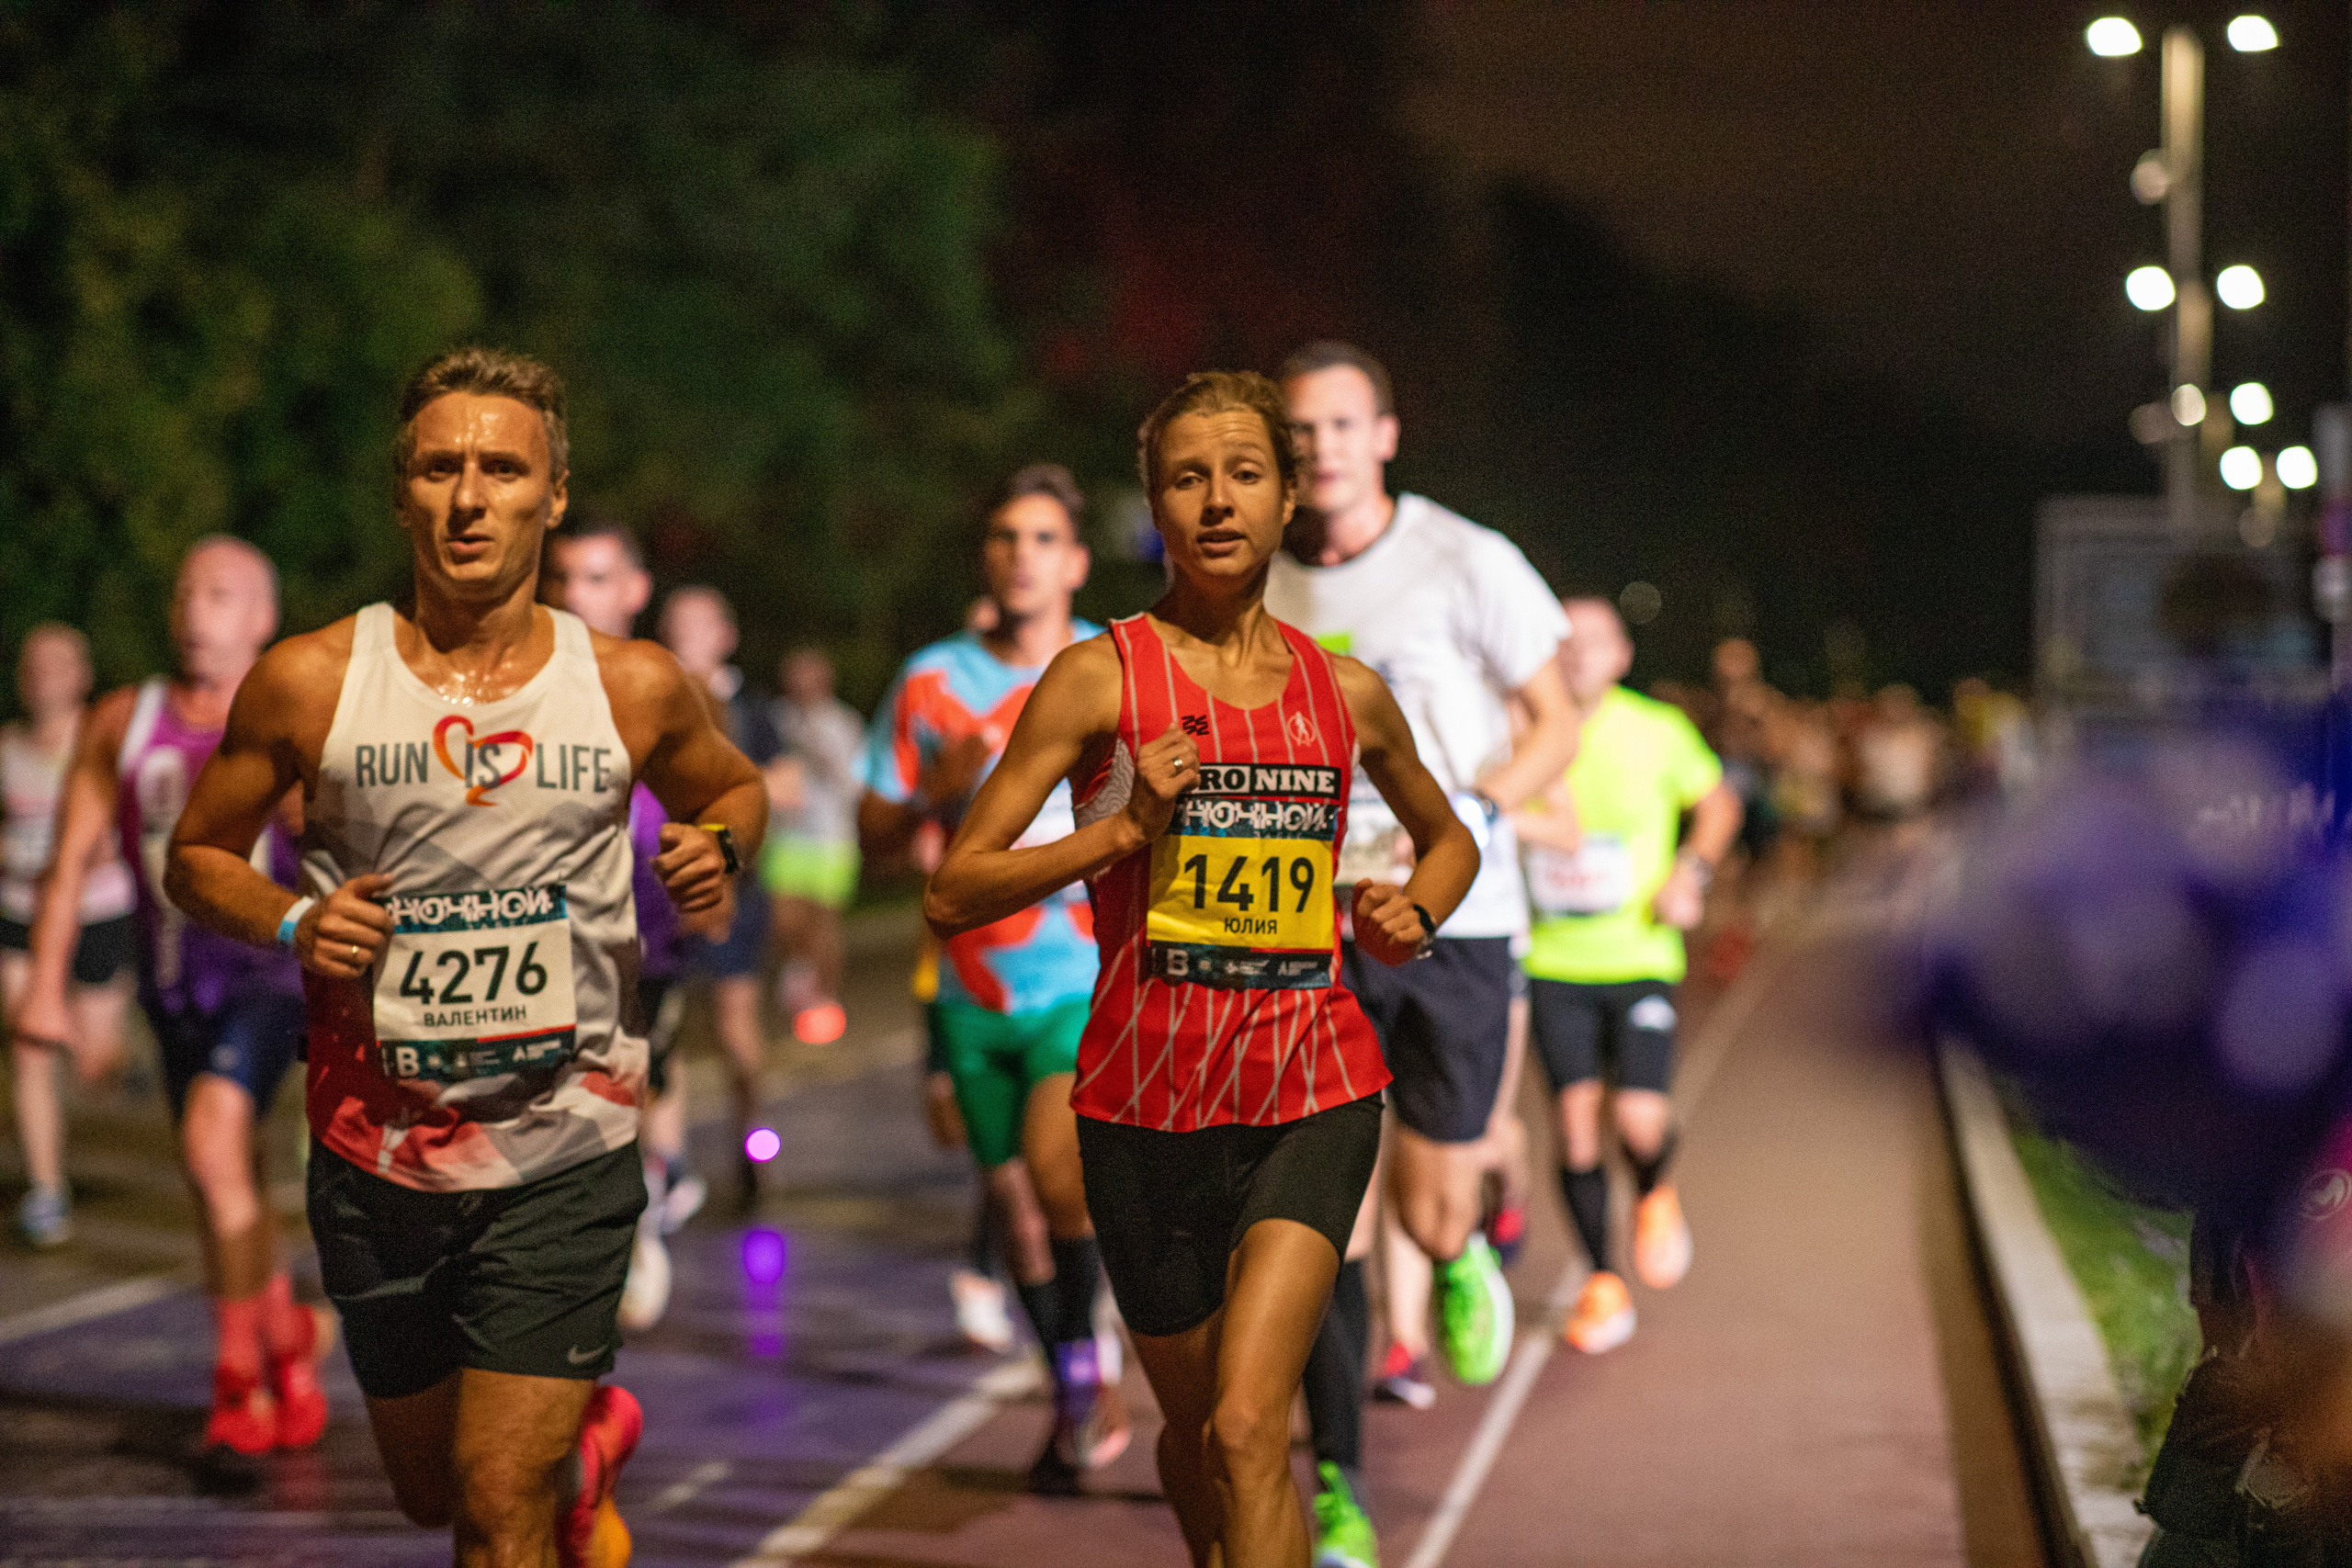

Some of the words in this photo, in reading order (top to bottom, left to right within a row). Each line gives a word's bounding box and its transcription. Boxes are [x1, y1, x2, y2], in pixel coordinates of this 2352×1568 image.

[356, 741, 429, 788] RUN
[465, 742, 501, 790] IS
[536, 742, 612, 794] LIFE
[1254, 768, 1335, 794] NINE
[1184, 853, 1315, 913] 1419
[1224, 917, 1278, 934] ЮЛИЯ
[399, 942, 548, 1005] 4276
[424, 1005, 527, 1028] ВАЛЕНТИН
